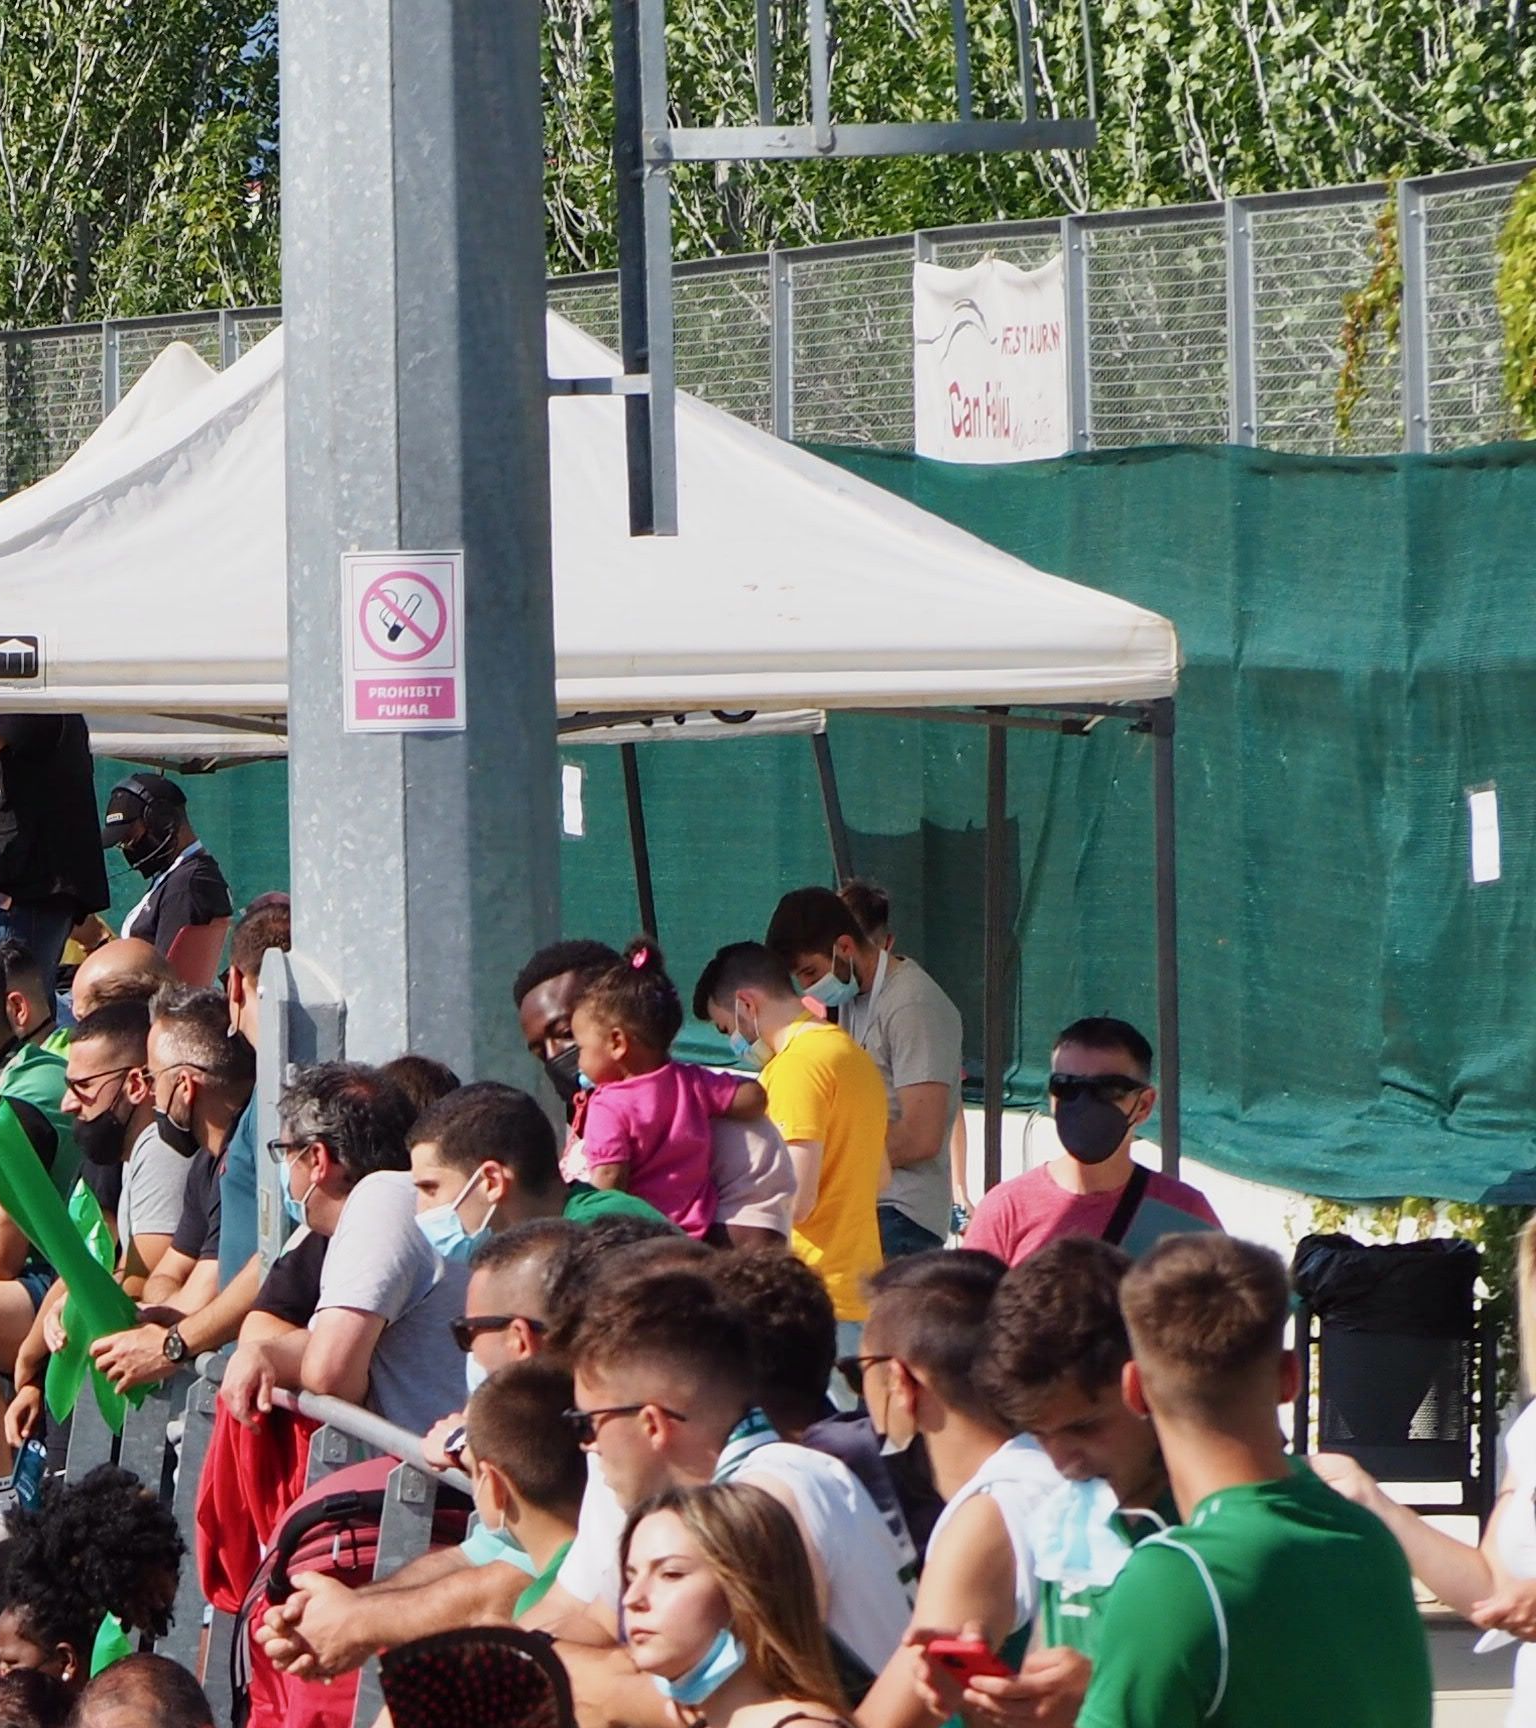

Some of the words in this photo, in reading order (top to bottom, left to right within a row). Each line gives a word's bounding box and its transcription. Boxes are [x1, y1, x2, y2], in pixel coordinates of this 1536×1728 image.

[948, 381, 982, 438] Can
[985, 380, 1012, 439] Feliu
[368, 684, 442, 699] PROHIBIT
[377, 703, 430, 717] FUMAR
